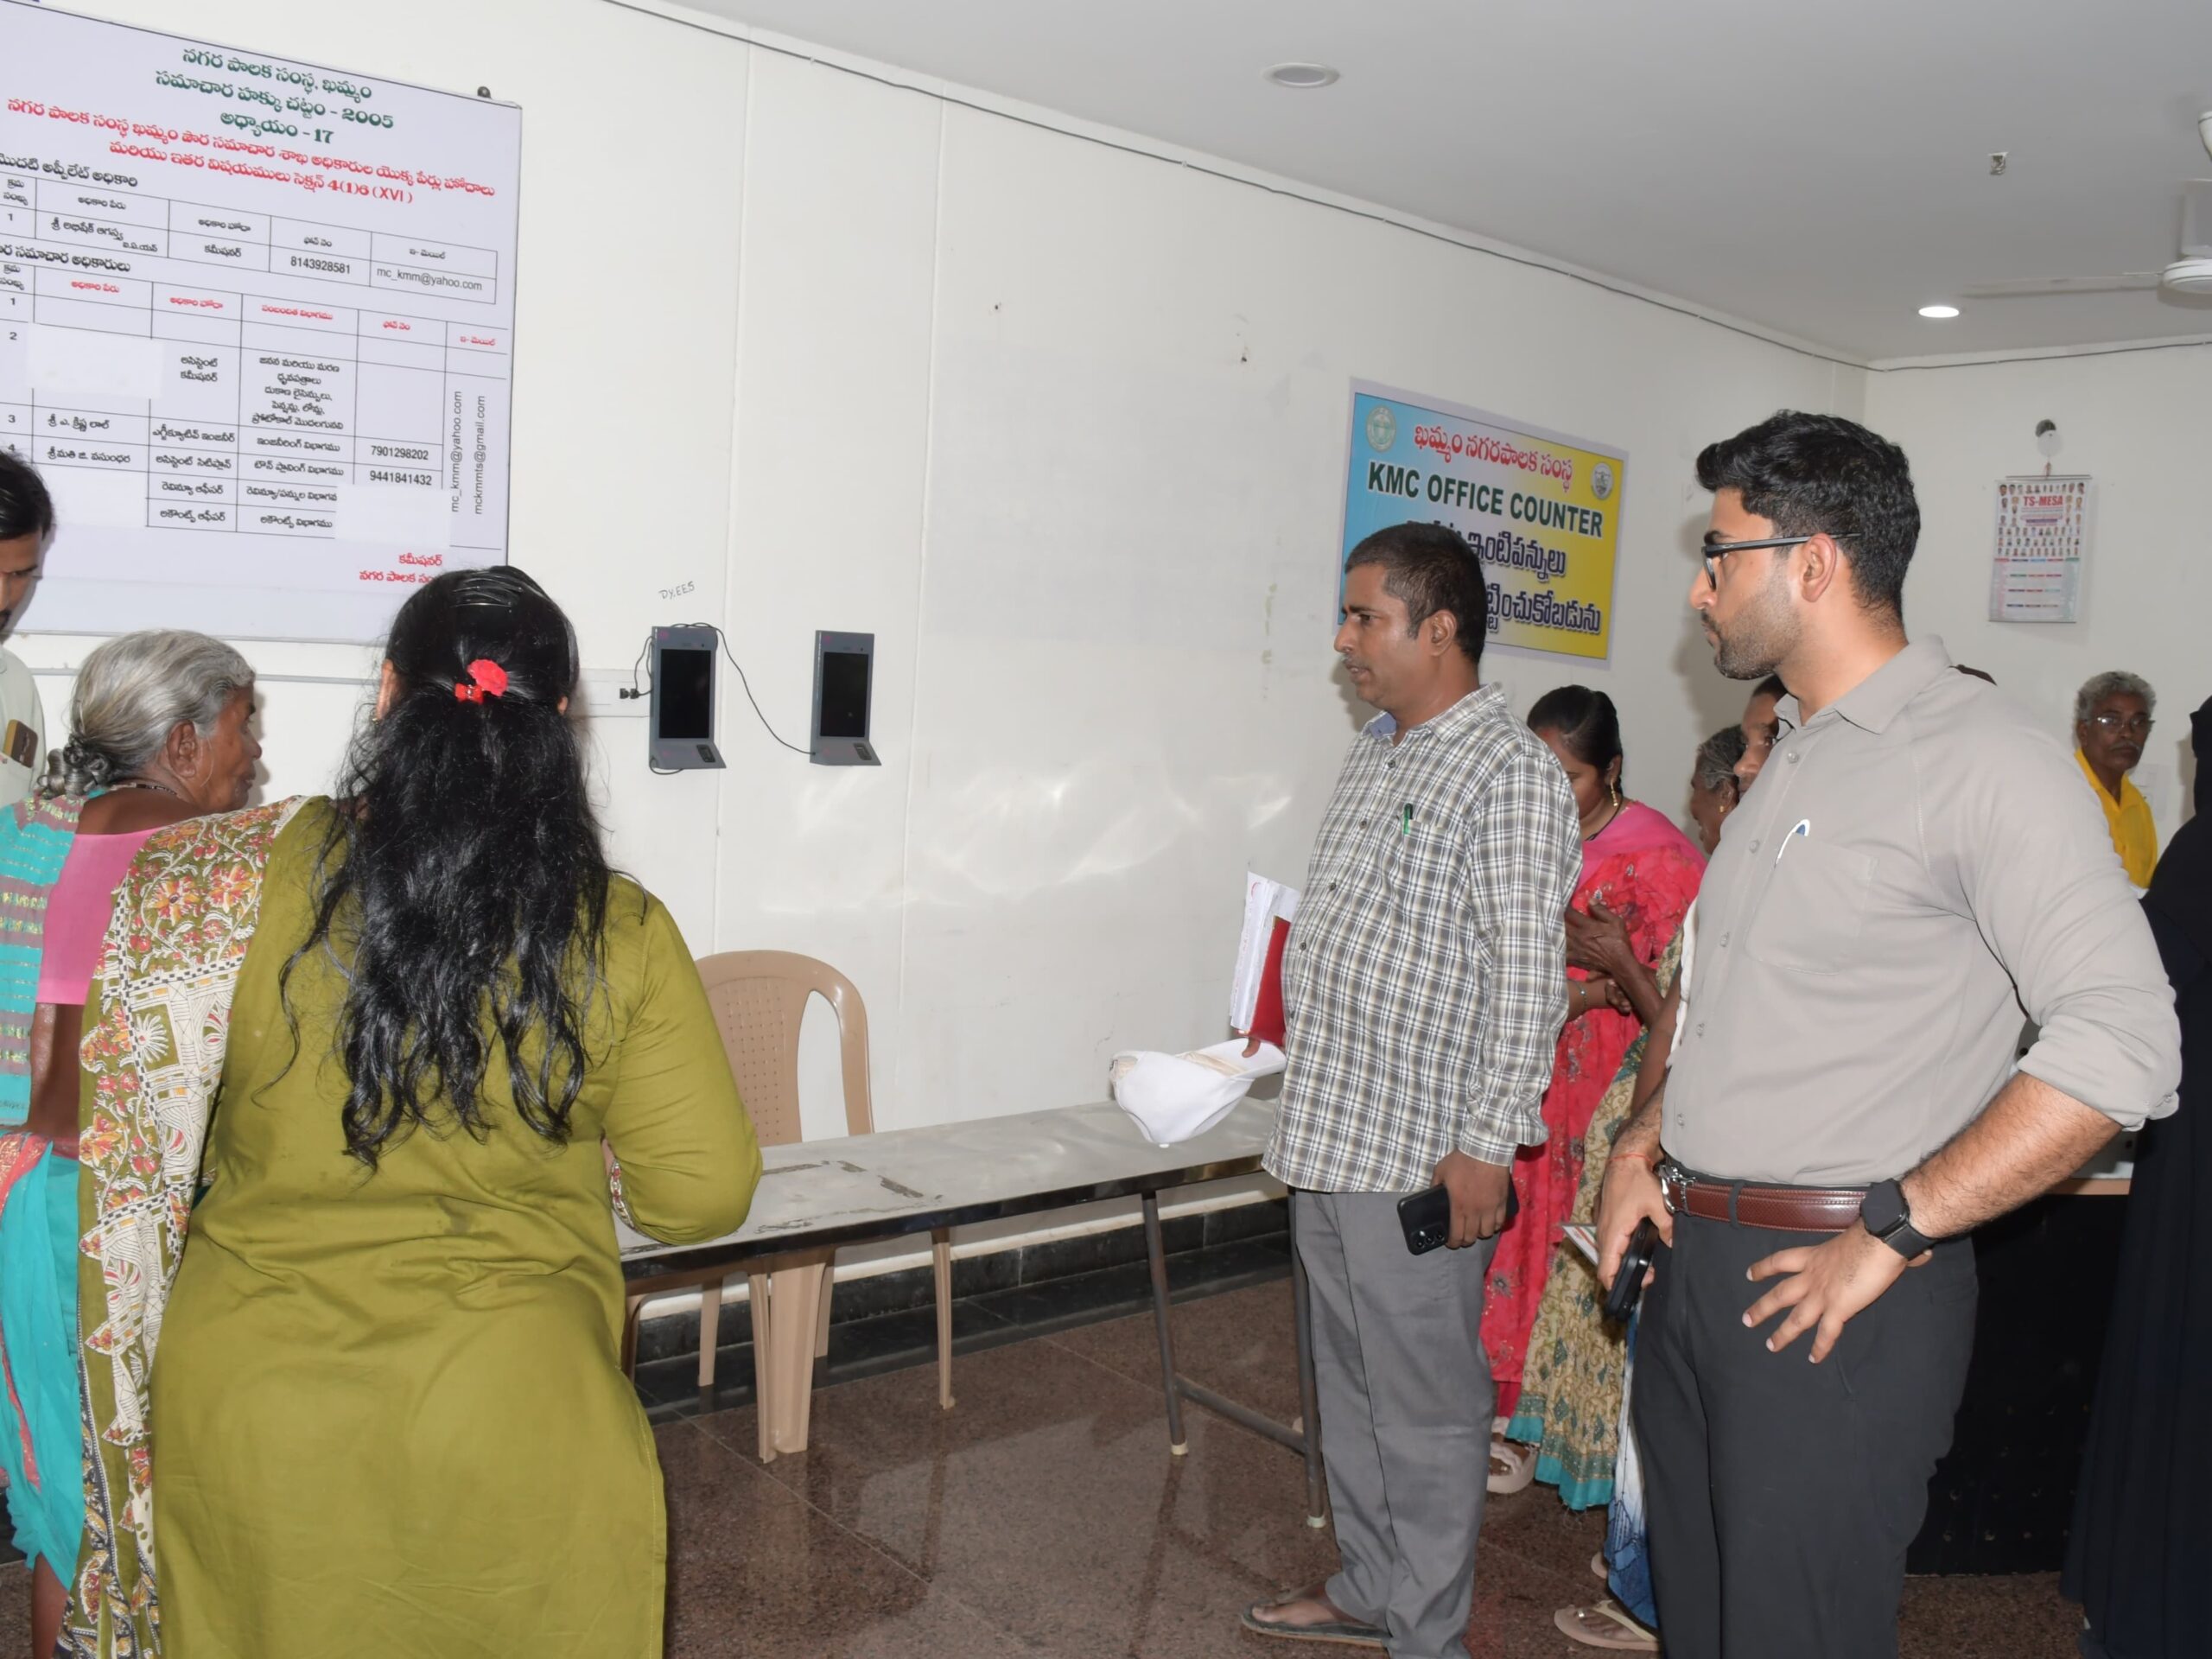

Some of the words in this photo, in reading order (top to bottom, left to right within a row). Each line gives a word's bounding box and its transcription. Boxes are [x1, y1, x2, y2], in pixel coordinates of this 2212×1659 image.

[182, 48, 223, 68] నగర
[227, 57, 272, 79] పాలక
[322, 79, 372, 103] ఖమ్మం
[156, 70, 234, 98] సమాచార
[238, 86, 283, 112] హక్కు
[286, 96, 326, 118] చట్టం
[341, 108, 394, 128] 2005
[220, 111, 298, 137] అధ్యాయం
[314, 129, 334, 144] 17
[8, 98, 45, 116] నగర
[48, 105, 90, 124] పాలక
[93, 113, 129, 137] సంస్థ
[132, 123, 179, 144] ఖమ్మం
[213, 137, 276, 156] సమాచార
[279, 148, 308, 165] శాఖ
[311, 154, 373, 175] అధికారుల
[376, 165, 415, 187] యొక్క
[444, 177, 496, 197] హోదాలు
[109, 140, 168, 162] మరియు
[171, 152, 205, 168] ఇతర
[208, 158, 290, 182] విషయములు
[92, 171, 138, 188] అధికారి
[16, 245, 68, 264] సమాచార
[72, 256, 130, 273] అధికారులు
[290, 256, 351, 274] 8143928581
[377, 267, 482, 291] mc_kmm@yahoo.com
[9, 415, 16, 423] 3
[371, 445, 429, 461] 7901298202
[450, 391, 463, 512] mc_kmm@yahoo.com
[474, 396, 486, 515] mckmmts@gmail.com
[1414, 425, 1463, 464] ఖమ్మం
[1465, 435, 1538, 472] నగరపాలక
[1541, 453, 1573, 493] సంస్థ
[370, 470, 432, 486] 9441841432
[1368, 461, 1420, 499] KMC
[1427, 474, 1503, 516] OFFICE
[1510, 493, 1603, 537] COUNTER
[359, 570, 384, 582] నగర
